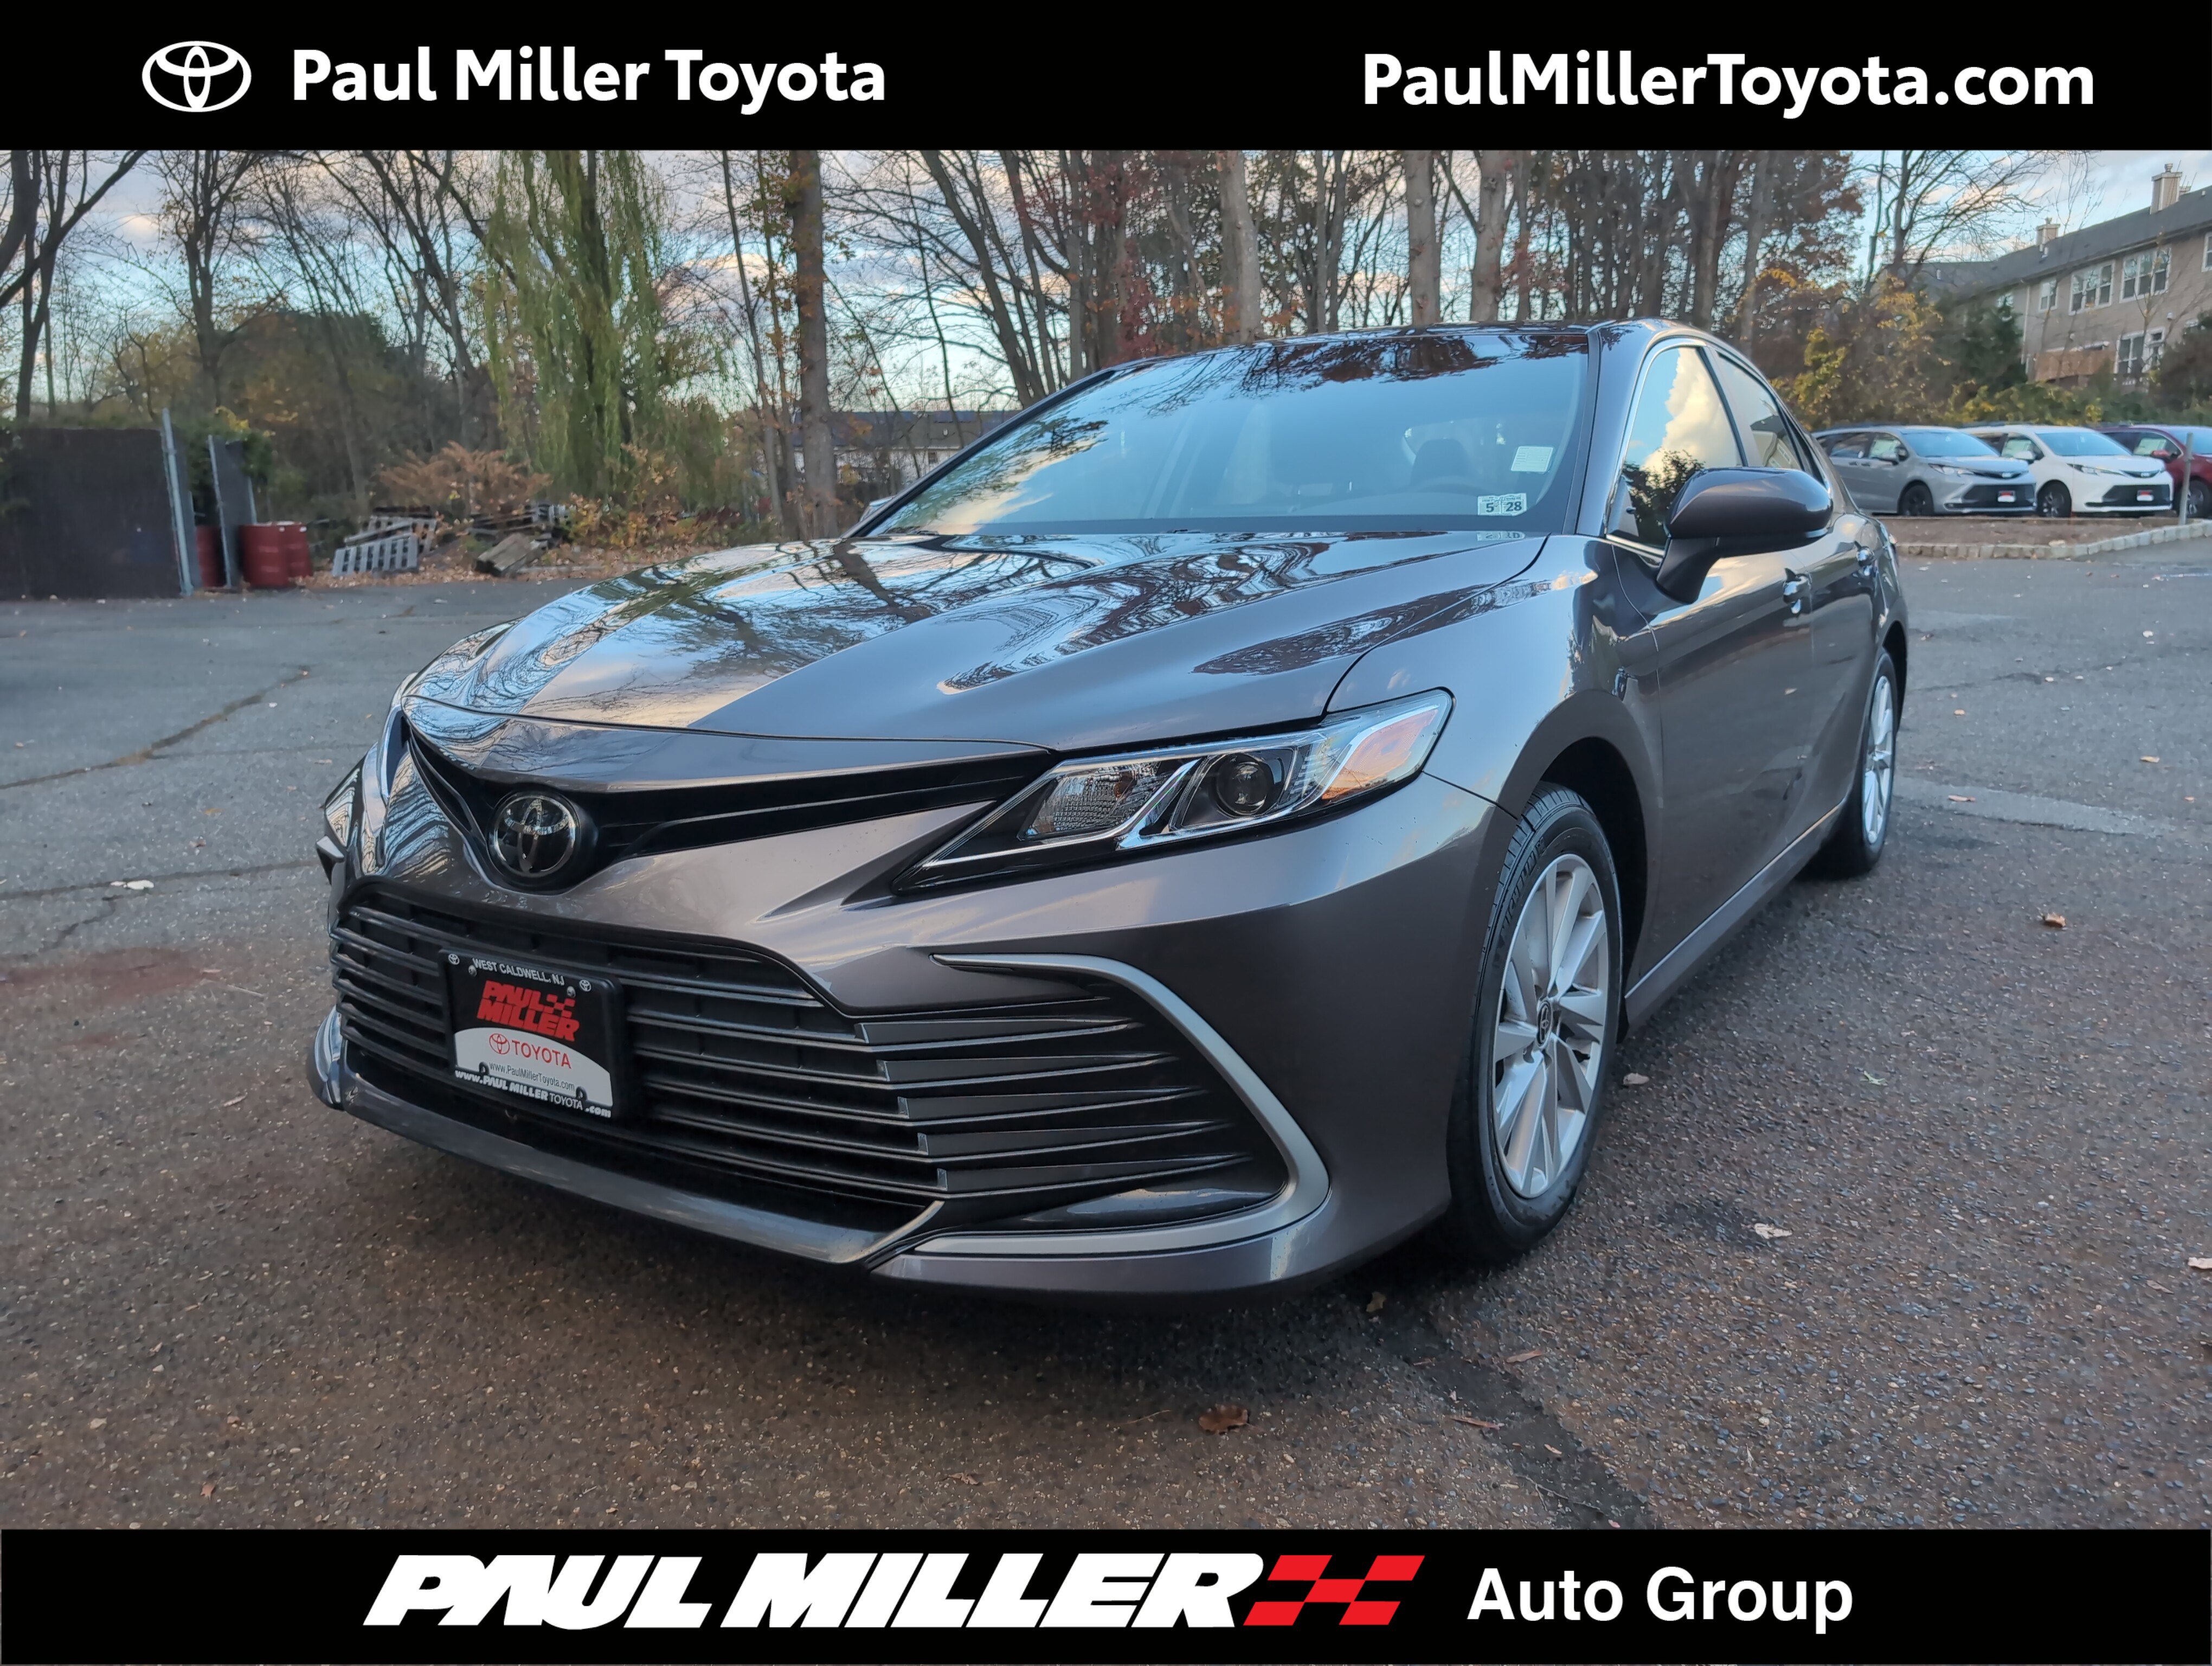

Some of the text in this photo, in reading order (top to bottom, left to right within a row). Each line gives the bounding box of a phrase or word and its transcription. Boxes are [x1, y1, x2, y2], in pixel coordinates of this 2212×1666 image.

[1486, 502, 1522, 512] 5 28
[472, 958, 497, 972] WEST
[552, 973, 565, 986] NJ
[483, 980, 544, 1012] PAUL
[477, 998, 580, 1042] MILLER
[512, 1040, 572, 1069] TOYOTA
[489, 1062, 575, 1092] www.PaulMillerToyota.com
[509, 1084, 548, 1101] MILLER
[550, 1092, 583, 1111] TOYOTA
[585, 1104, 612, 1118] .com
